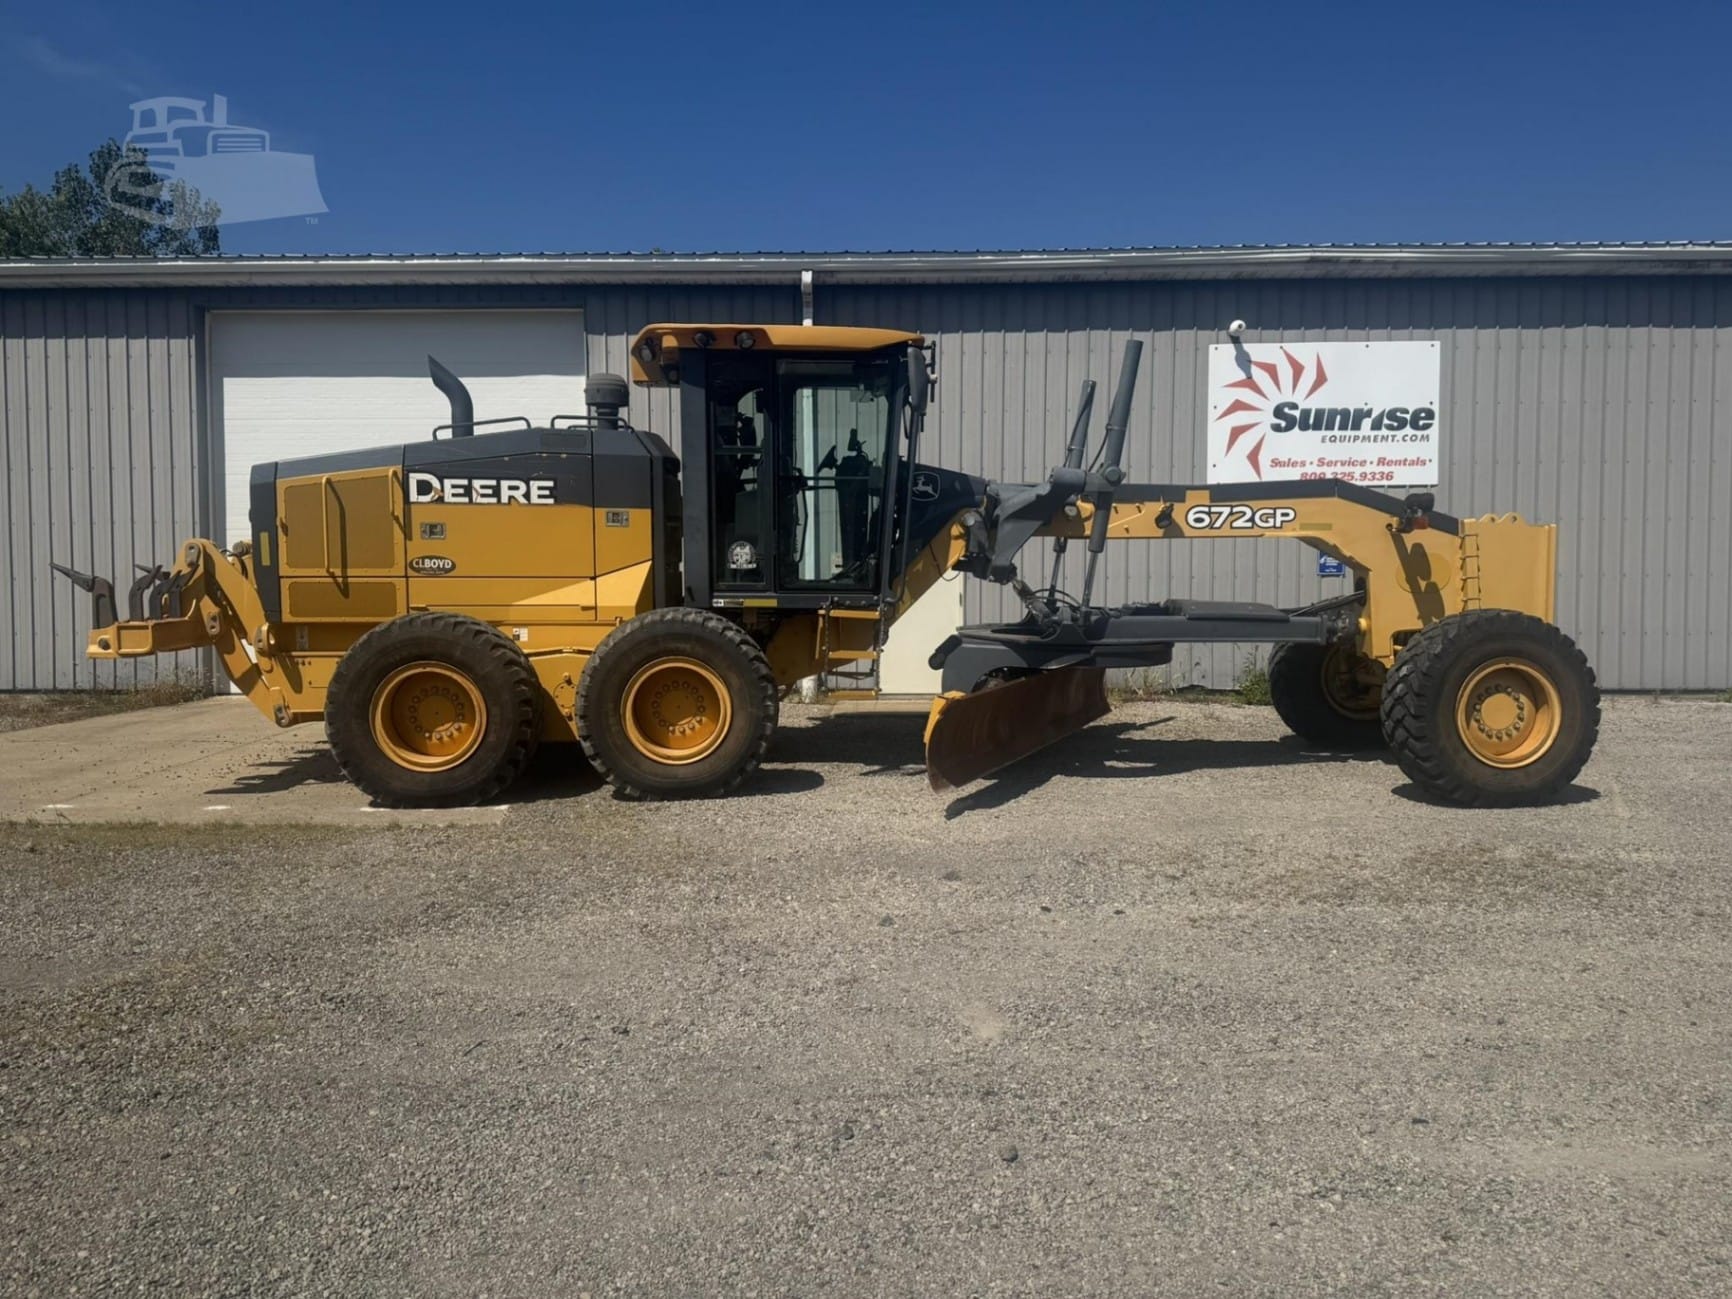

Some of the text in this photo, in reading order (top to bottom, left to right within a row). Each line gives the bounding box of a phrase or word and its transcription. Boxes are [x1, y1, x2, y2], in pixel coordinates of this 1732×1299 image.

[1270, 401, 1435, 433] Sunrise
[1321, 434, 1430, 444] EQUIPMENT.COM
[1270, 456, 1427, 468] Sales Service Rentals
[408, 472, 555, 504] DEERE
[1186, 505, 1296, 529] 672GP
